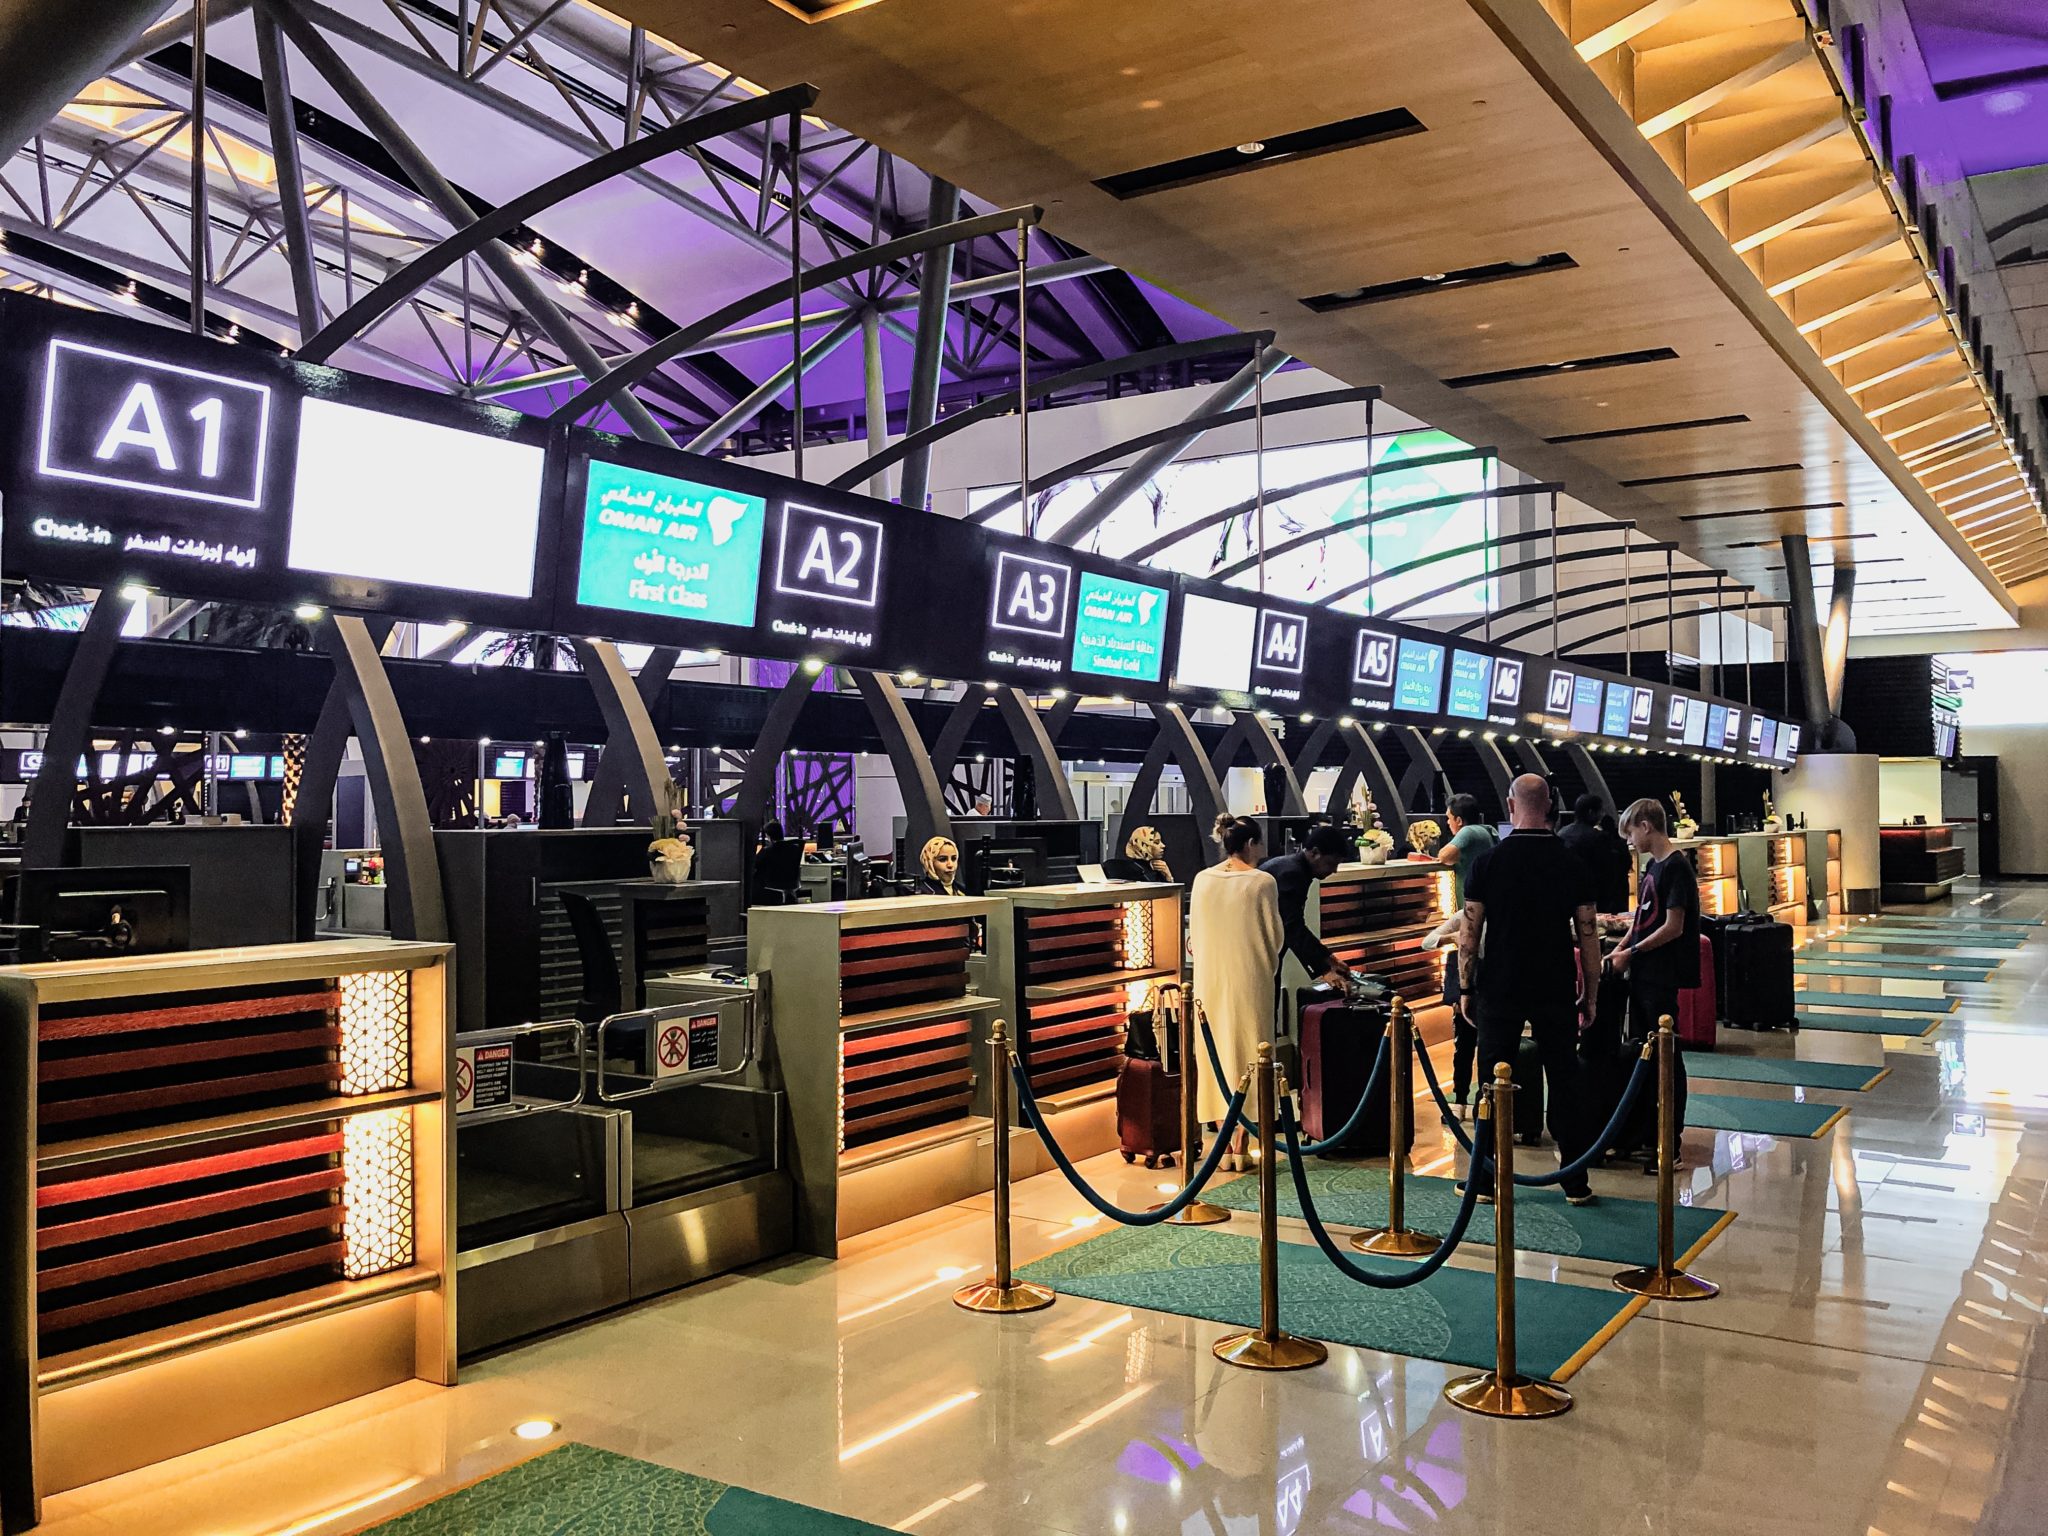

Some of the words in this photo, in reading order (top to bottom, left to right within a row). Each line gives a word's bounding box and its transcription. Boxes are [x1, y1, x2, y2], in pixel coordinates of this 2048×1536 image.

[95, 383, 225, 477] A1
[34, 518, 111, 544] Check-in
[599, 509, 663, 534] OMAN
[664, 522, 698, 541] AIR
[798, 526, 863, 589] A2
[629, 579, 665, 602] First
[668, 585, 708, 608] Class
[1009, 571, 1056, 622] A3
[1084, 606, 1115, 620] OMAN
[1116, 611, 1134, 623] AIR
[1266, 622, 1297, 662] A4
[1093, 654, 1123, 669] Sindbad
[1362, 640, 1389, 676] A5
[1497, 668, 1517, 697] A6
[1552, 678, 1569, 705] A7
[484, 1048, 509, 1059] DANGER
